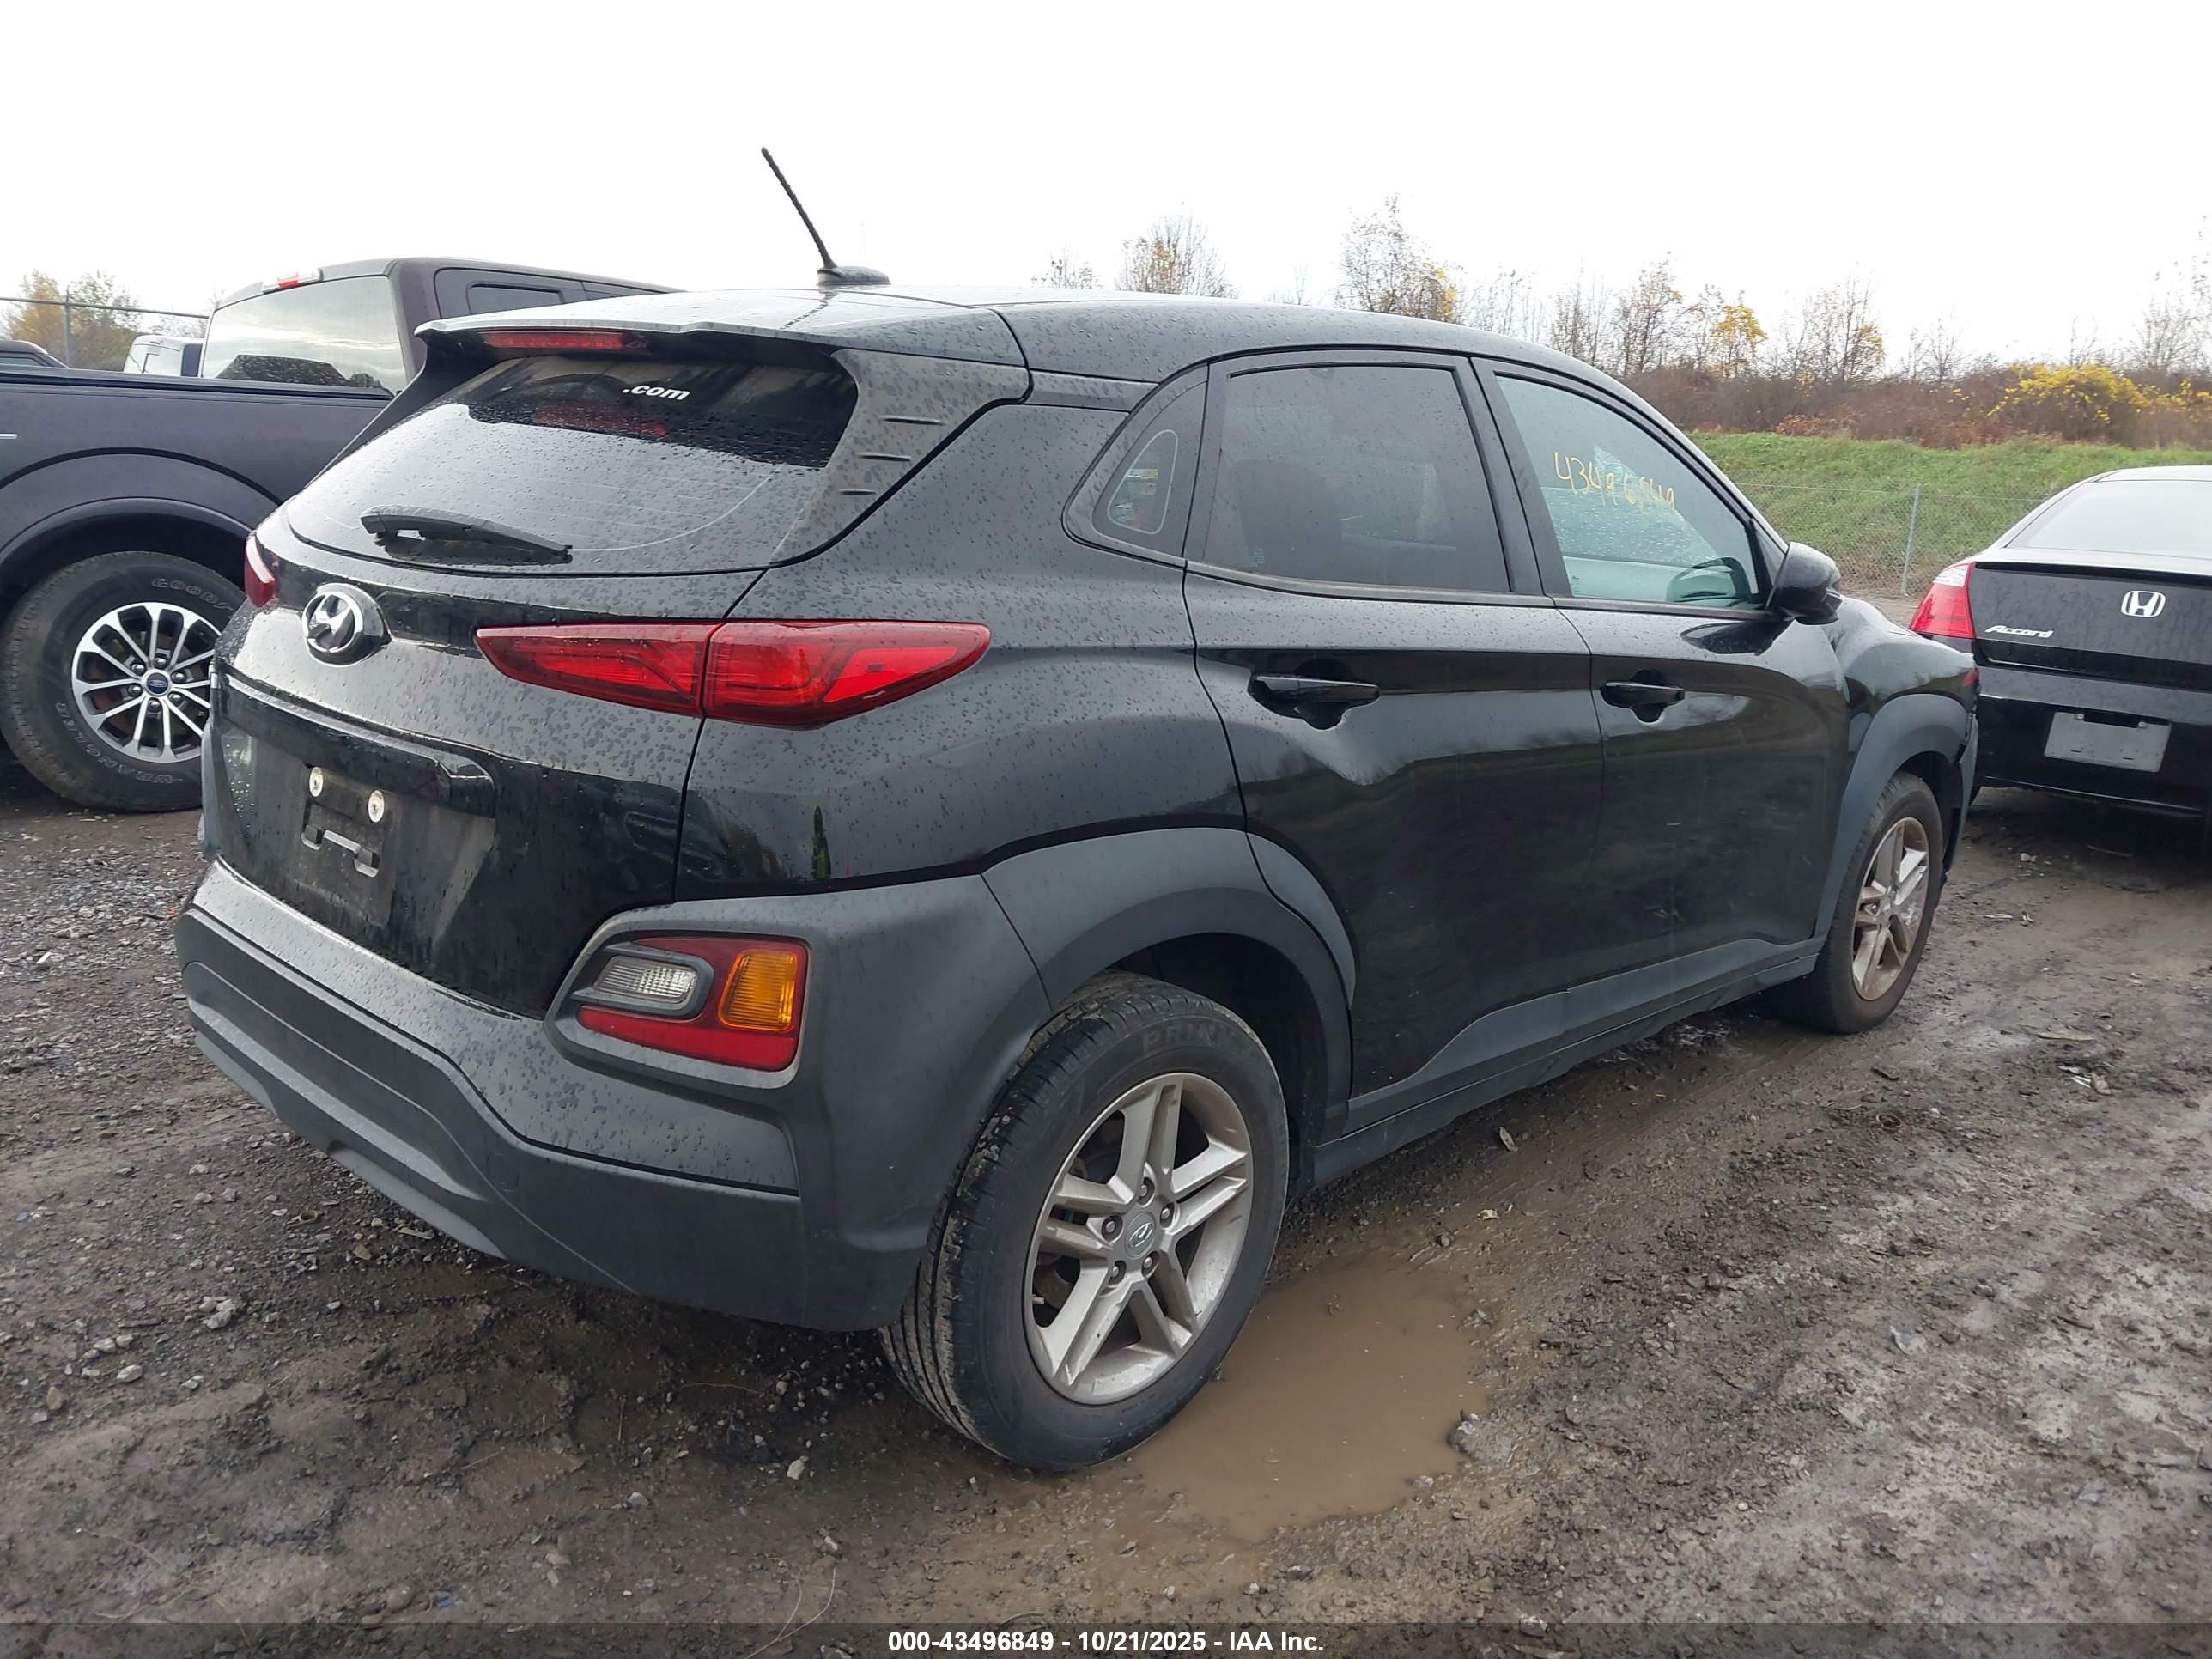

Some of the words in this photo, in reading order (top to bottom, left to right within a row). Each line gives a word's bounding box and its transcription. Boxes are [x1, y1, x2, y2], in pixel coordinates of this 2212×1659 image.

[623, 385, 690, 400] .com
[151, 577, 234, 611] GOODY
[1984, 625, 2054, 638] Accord
